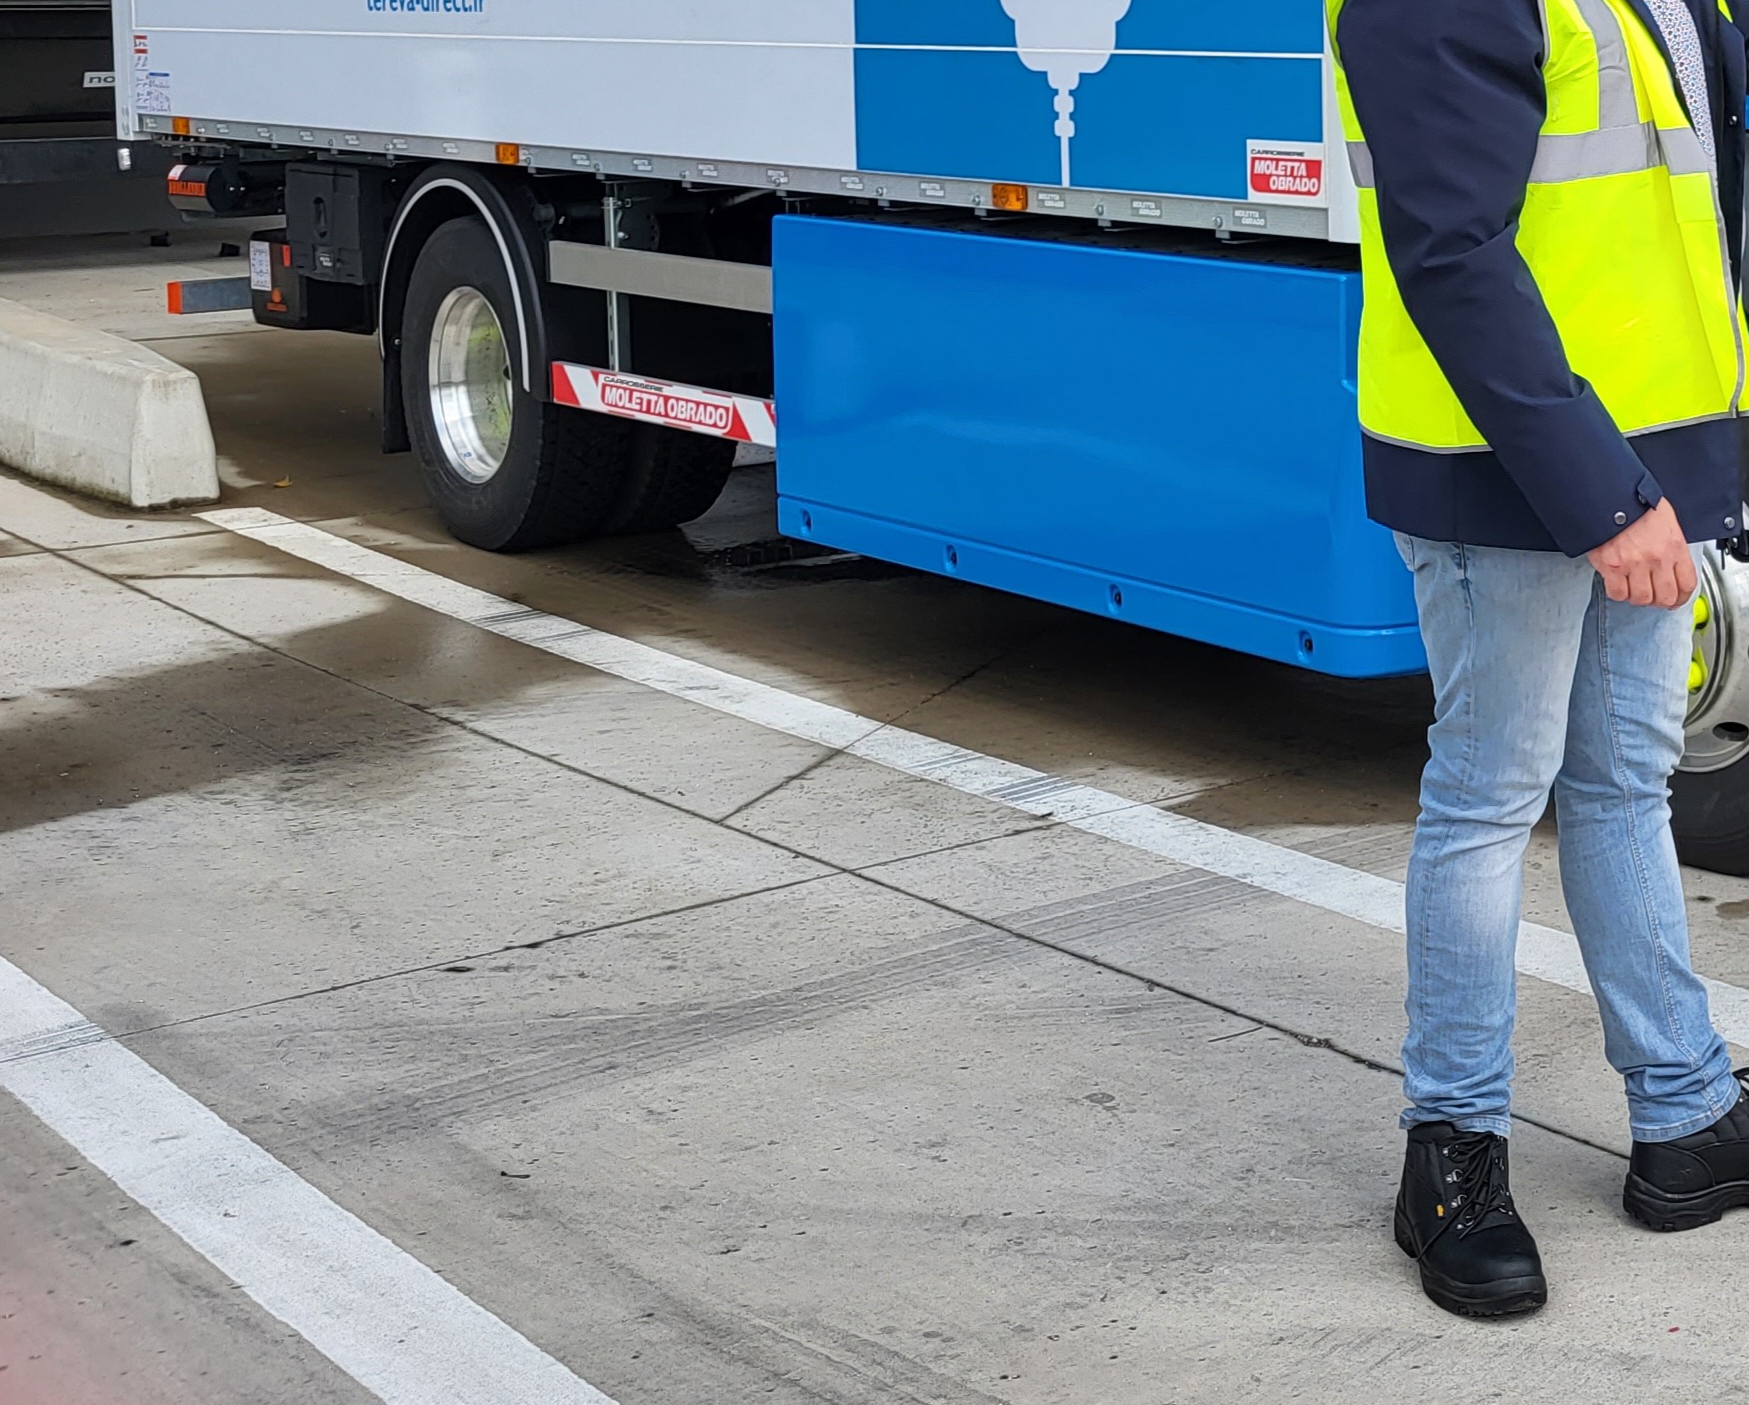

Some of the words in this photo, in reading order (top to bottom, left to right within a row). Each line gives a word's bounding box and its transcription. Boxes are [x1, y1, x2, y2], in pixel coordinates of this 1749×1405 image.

[1253, 160, 1307, 177] MOLETTA
[1269, 176, 1319, 193] OBRADO
[604, 387, 666, 416] MOLETTA
[667, 399, 727, 428] OBRADO
